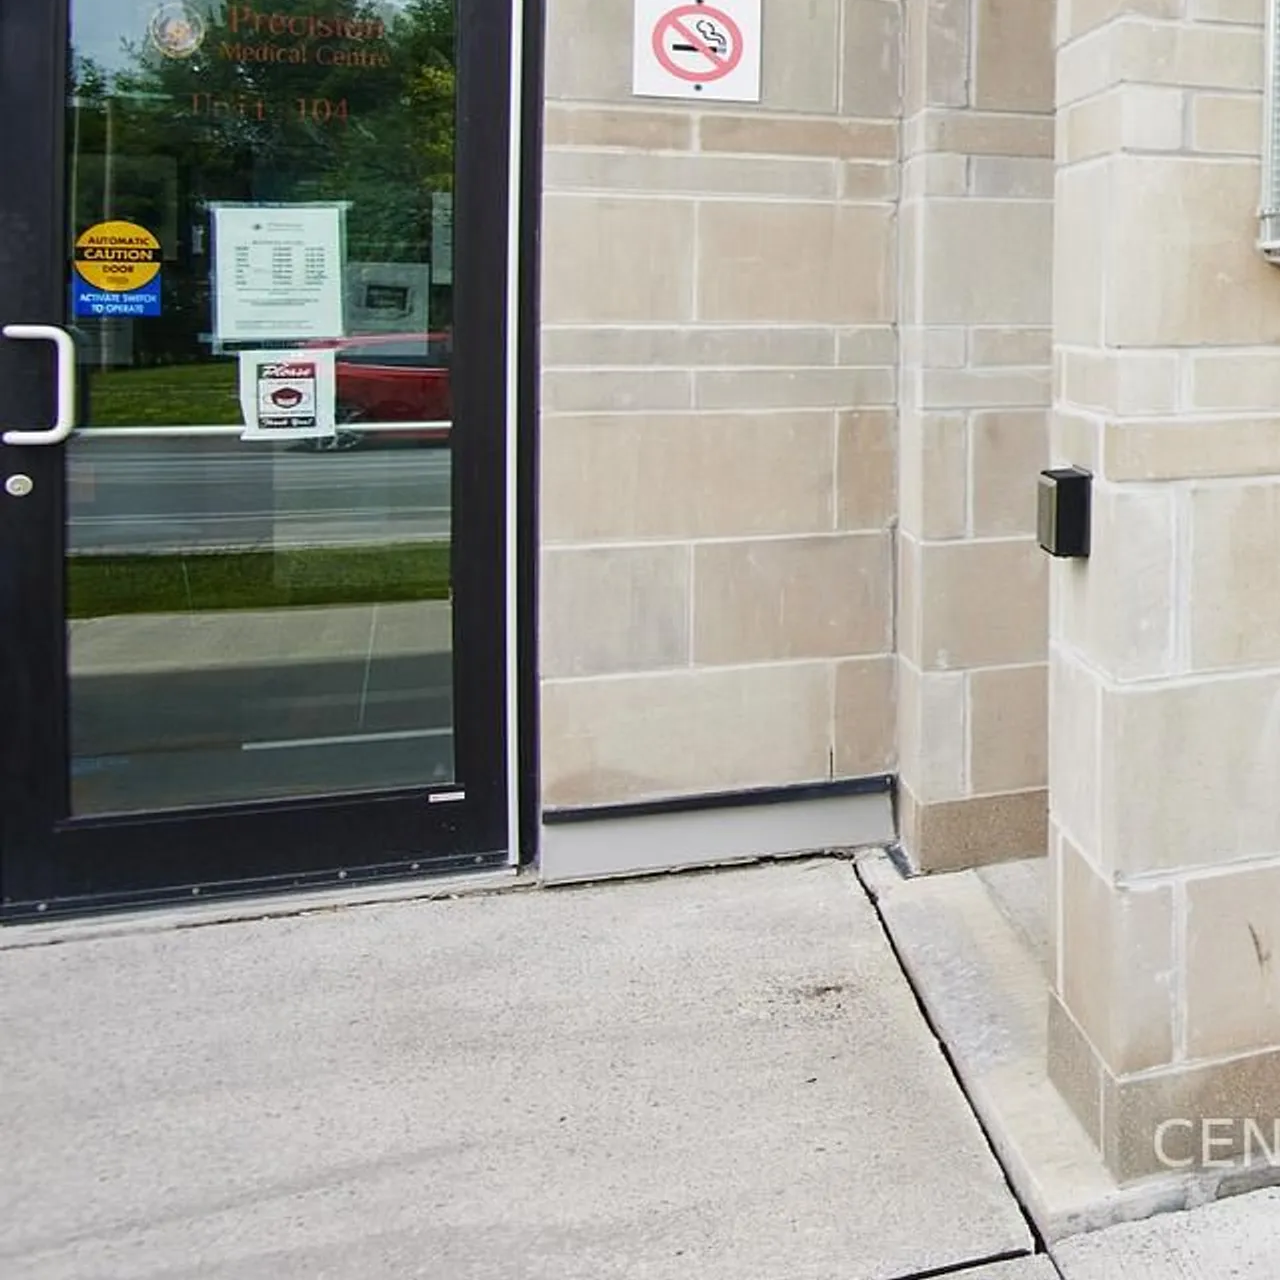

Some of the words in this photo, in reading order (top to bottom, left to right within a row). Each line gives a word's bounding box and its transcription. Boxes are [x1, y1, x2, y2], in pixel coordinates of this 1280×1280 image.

[227, 5, 386, 40] Precision
[220, 41, 307, 65] Medical
[315, 45, 392, 68] Centre
[298, 97, 350, 124] 104
[87, 236, 150, 245] AUTOMATIC
[84, 249, 154, 260] CAUTION
[262, 361, 313, 377] Please
